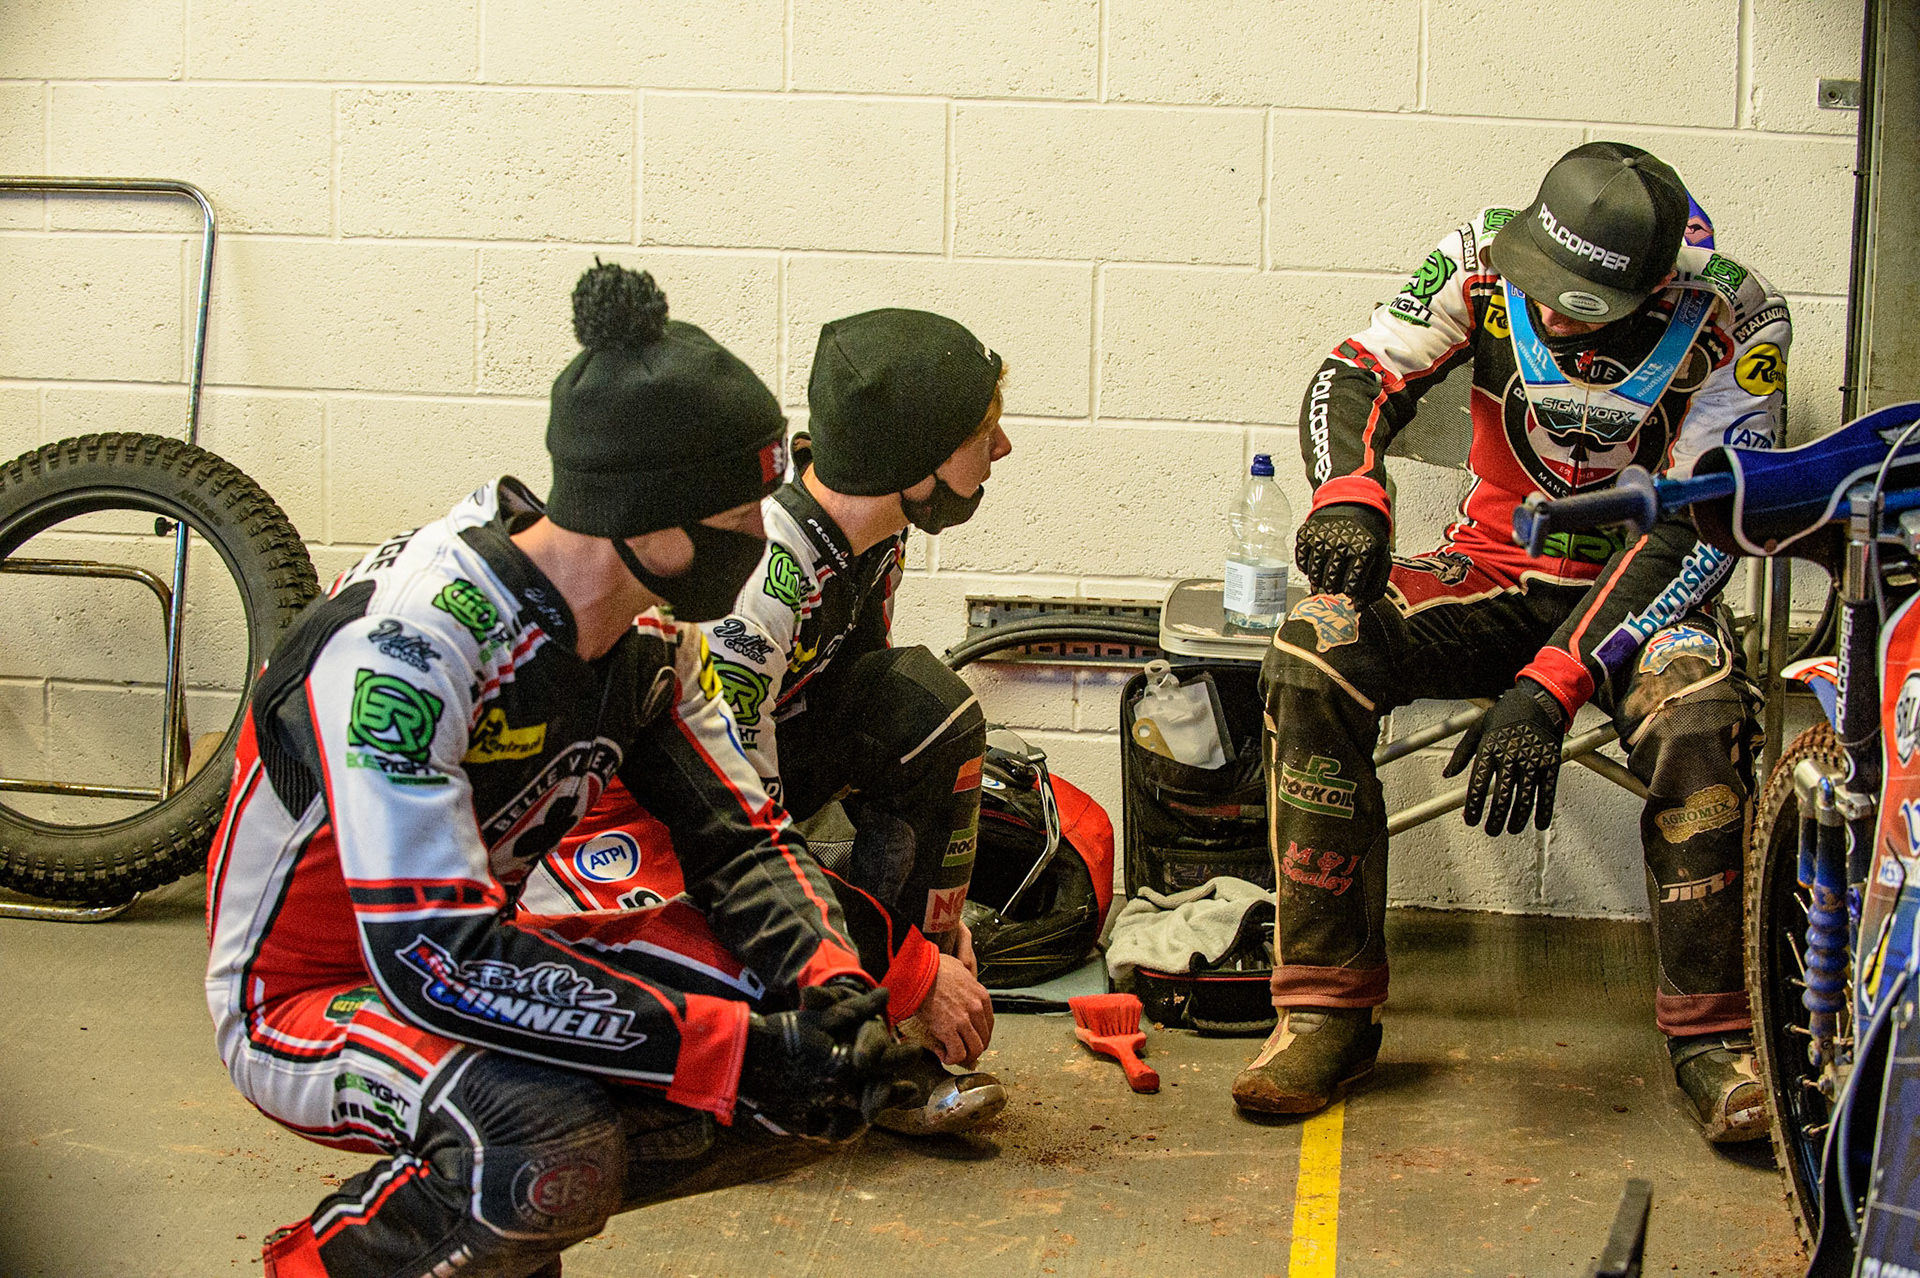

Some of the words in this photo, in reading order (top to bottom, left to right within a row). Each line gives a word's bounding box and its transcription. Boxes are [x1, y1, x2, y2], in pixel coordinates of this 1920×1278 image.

[1538, 202, 1631, 272] POLCOPPER
[1835, 605, 1855, 735] POLCOPPER
[589, 845, 627, 870] ATPI
